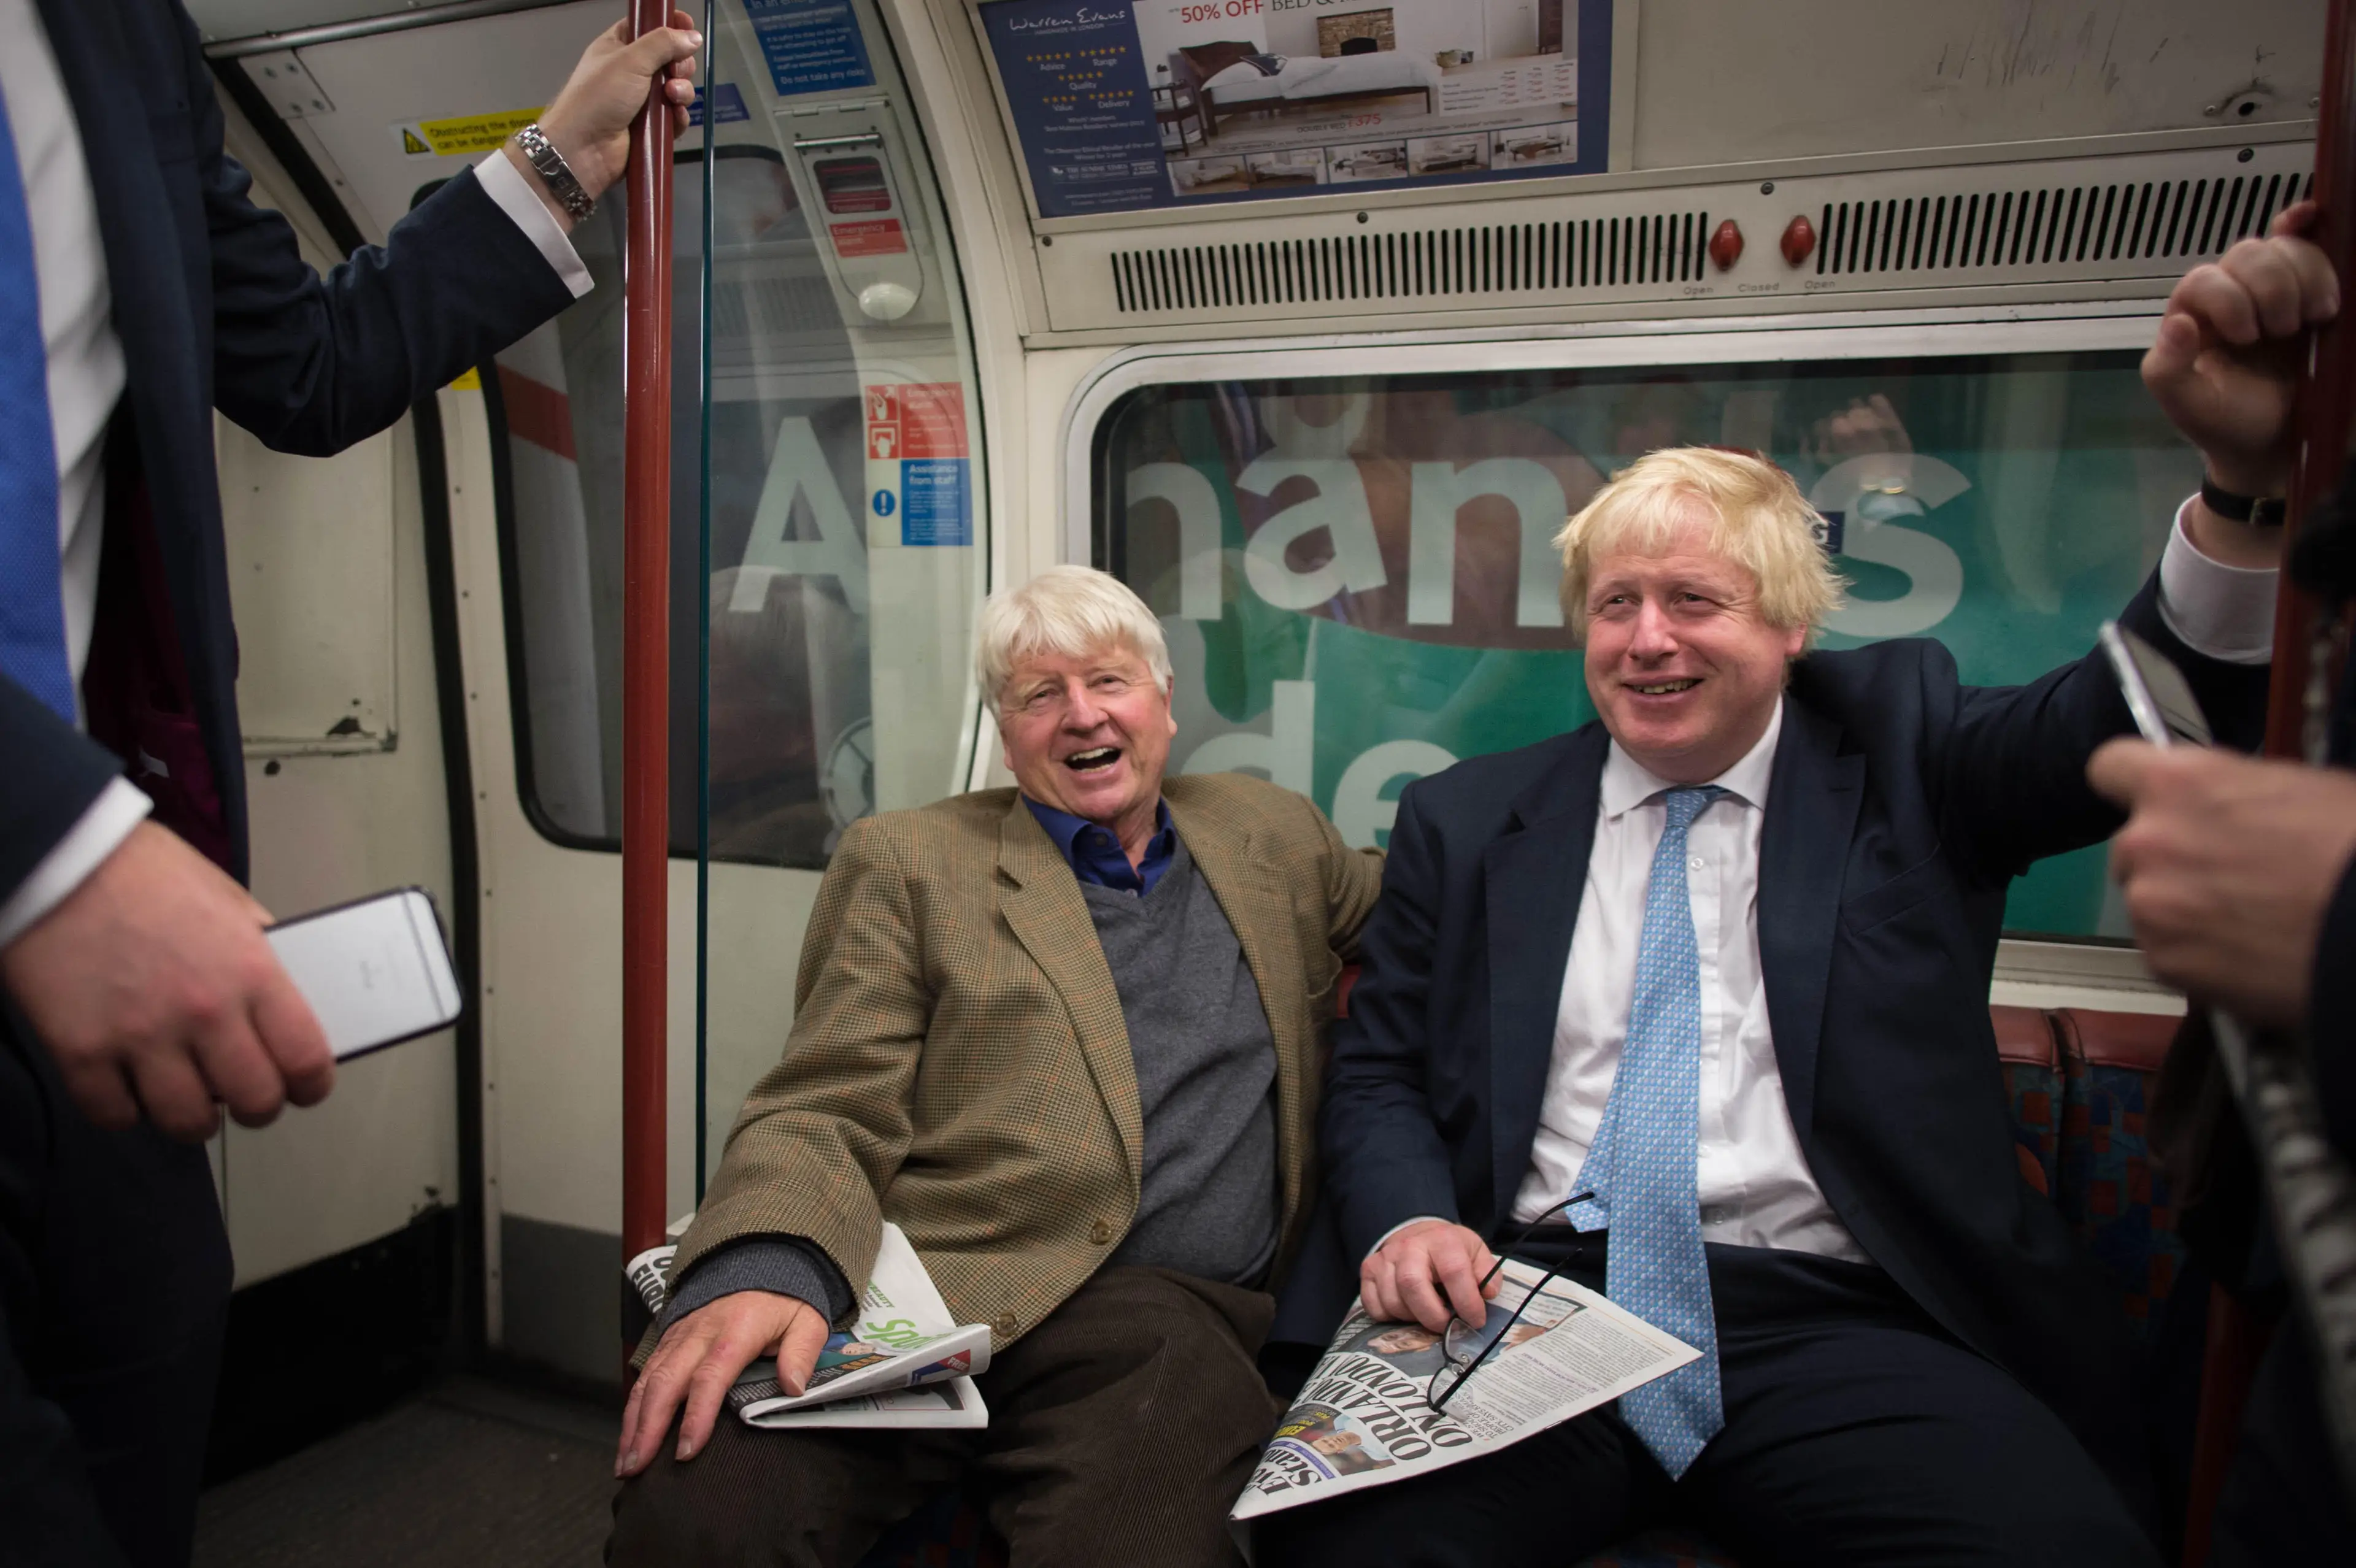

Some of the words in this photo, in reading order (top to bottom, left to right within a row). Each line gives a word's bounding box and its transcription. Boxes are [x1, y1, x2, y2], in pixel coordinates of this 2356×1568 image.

[1181, 5, 1222, 23] 50%
[1226, 0, 1265, 17] OFF
[1009, 17, 1073, 31] Warren
[1076, 7, 1126, 23] Evans
[1093, 58, 1117, 67] Range
[780, 76, 793, 85] Do
[794, 74, 809, 83] not
[810, 72, 829, 81] take
[830, 71, 844, 80] any
[846, 68, 866, 77] risks
[1069, 82, 1098, 91] Quality
[1098, 99, 1130, 109] Delivery
[429, 123, 489, 139] Obstructing
[488, 121, 507, 130] the
[437, 141, 455, 150] can
[832, 224, 885, 236] Emergency
[1684, 286, 1714, 295] Open
[1738, 282, 1779, 292] Closed
[1804, 280, 1836, 290] Open
[909, 475, 932, 484] from
[947, 1356, 969, 1371] FREE
[1410, 1413, 1472, 1447] ON
[1479, 1418, 1506, 1435] PEOPLE
